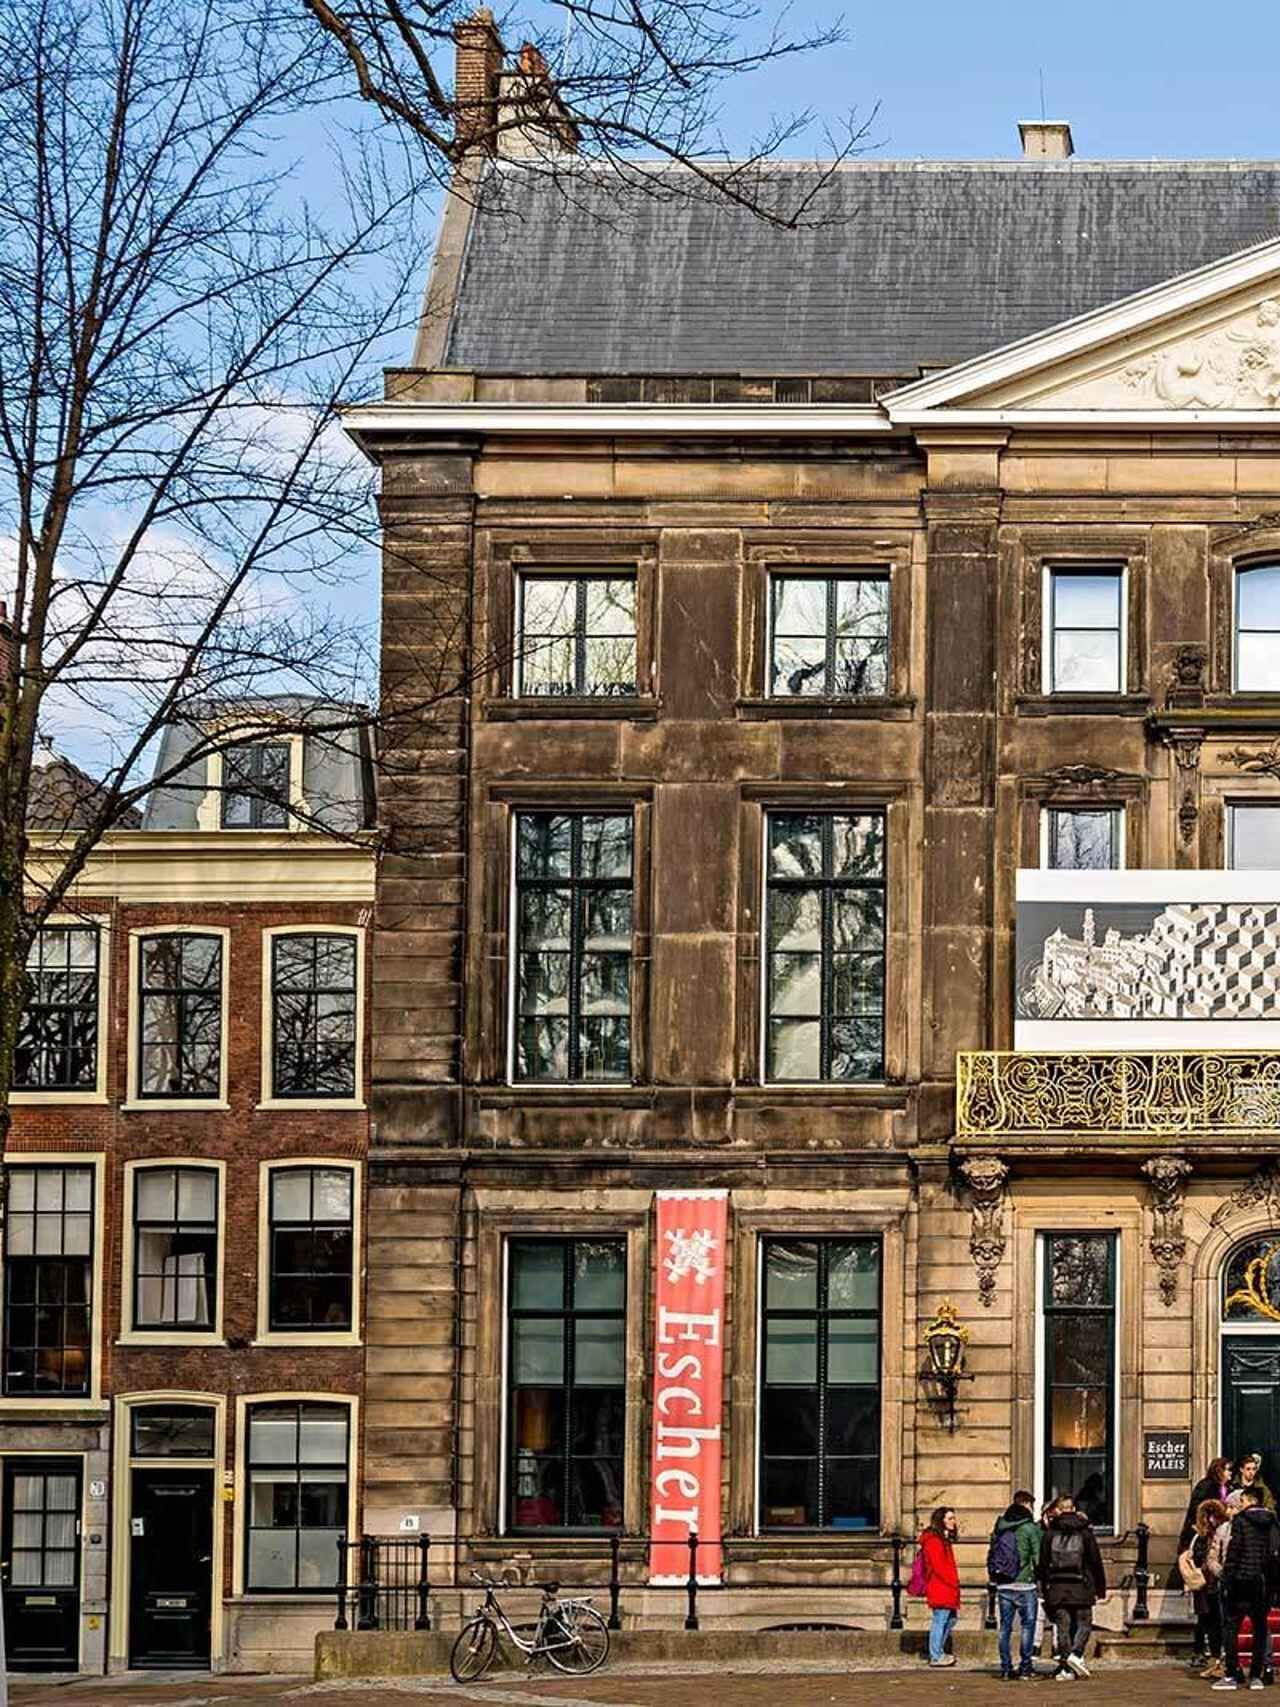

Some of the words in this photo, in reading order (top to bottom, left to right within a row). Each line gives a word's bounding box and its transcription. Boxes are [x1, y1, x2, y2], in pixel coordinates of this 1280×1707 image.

[655, 1305, 720, 1534] Escher
[1148, 1440, 1185, 1453] Escher
[1148, 1459, 1185, 1470] PALEIS
